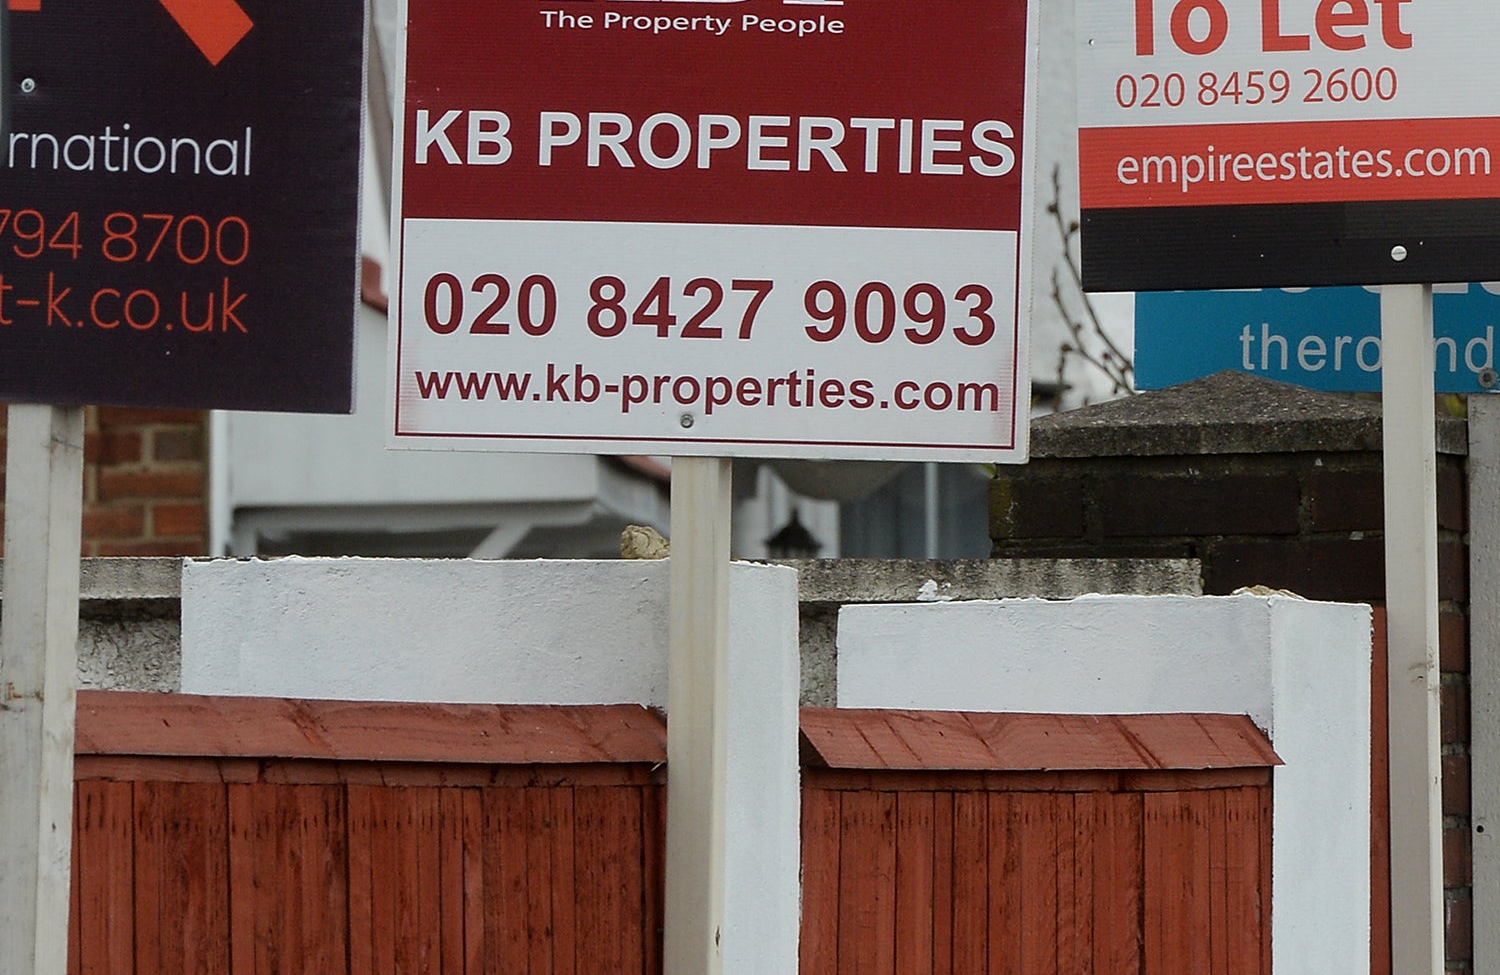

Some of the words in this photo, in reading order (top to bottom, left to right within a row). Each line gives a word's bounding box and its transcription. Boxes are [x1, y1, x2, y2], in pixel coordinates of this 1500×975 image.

[539, 9, 595, 30] The
[603, 11, 733, 36] Property
[741, 14, 846, 38] People
[1115, 72, 1187, 109] 020
[1196, 68, 1291, 107] 8459
[1302, 65, 1399, 104] 2600
[8, 123, 252, 177] rnational
[413, 109, 515, 167] KB
[537, 111, 1017, 178] PROPERTIES
[1116, 144, 1493, 193] empireestates.com
[101, 211, 251, 266] 8700
[422, 272, 559, 337] 020
[586, 274, 776, 341] 8427
[802, 278, 998, 346] 9093
[414, 362, 1000, 416] www.kb-properties.com
